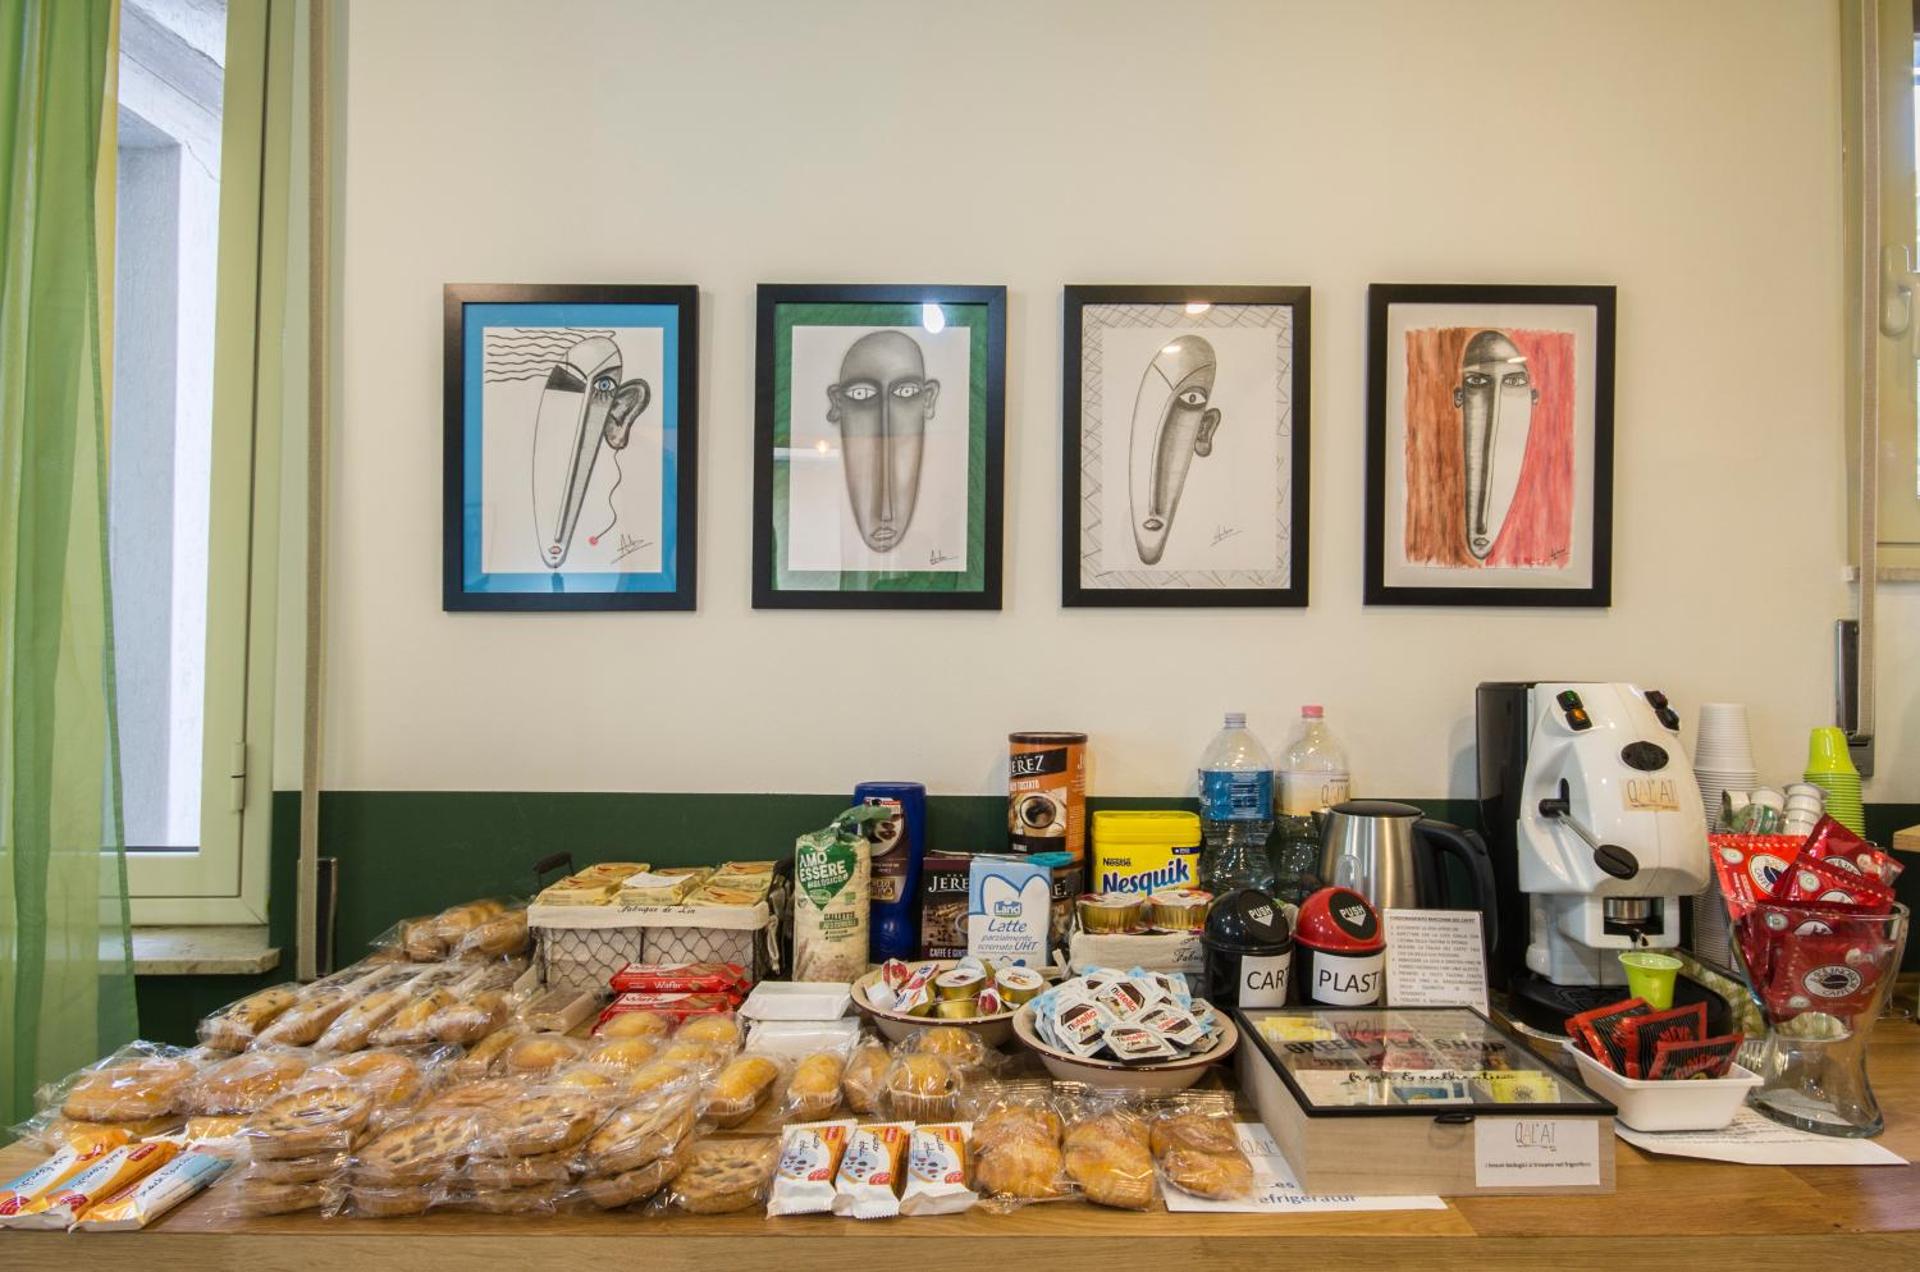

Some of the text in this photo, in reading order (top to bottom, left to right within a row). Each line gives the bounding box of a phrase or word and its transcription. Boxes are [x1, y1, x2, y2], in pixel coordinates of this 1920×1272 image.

[800, 852, 828, 868] AMO
[800, 860, 847, 882] ESSERE
[1102, 858, 1190, 896] Nesquik
[928, 875, 969, 893] JERE
[1249, 905, 1273, 920] PUSH
[1339, 905, 1366, 919] PUSH
[988, 918, 1028, 933] Latte
[981, 934, 1032, 943] parzialmente
[1014, 941, 1040, 951] UHT
[1319, 968, 1381, 993] PLAST
[1110, 987, 1137, 1013] nutella
[1067, 1010, 1098, 1031] nutella
[1284, 1039, 1506, 1054] GREEN TEA SHOP
